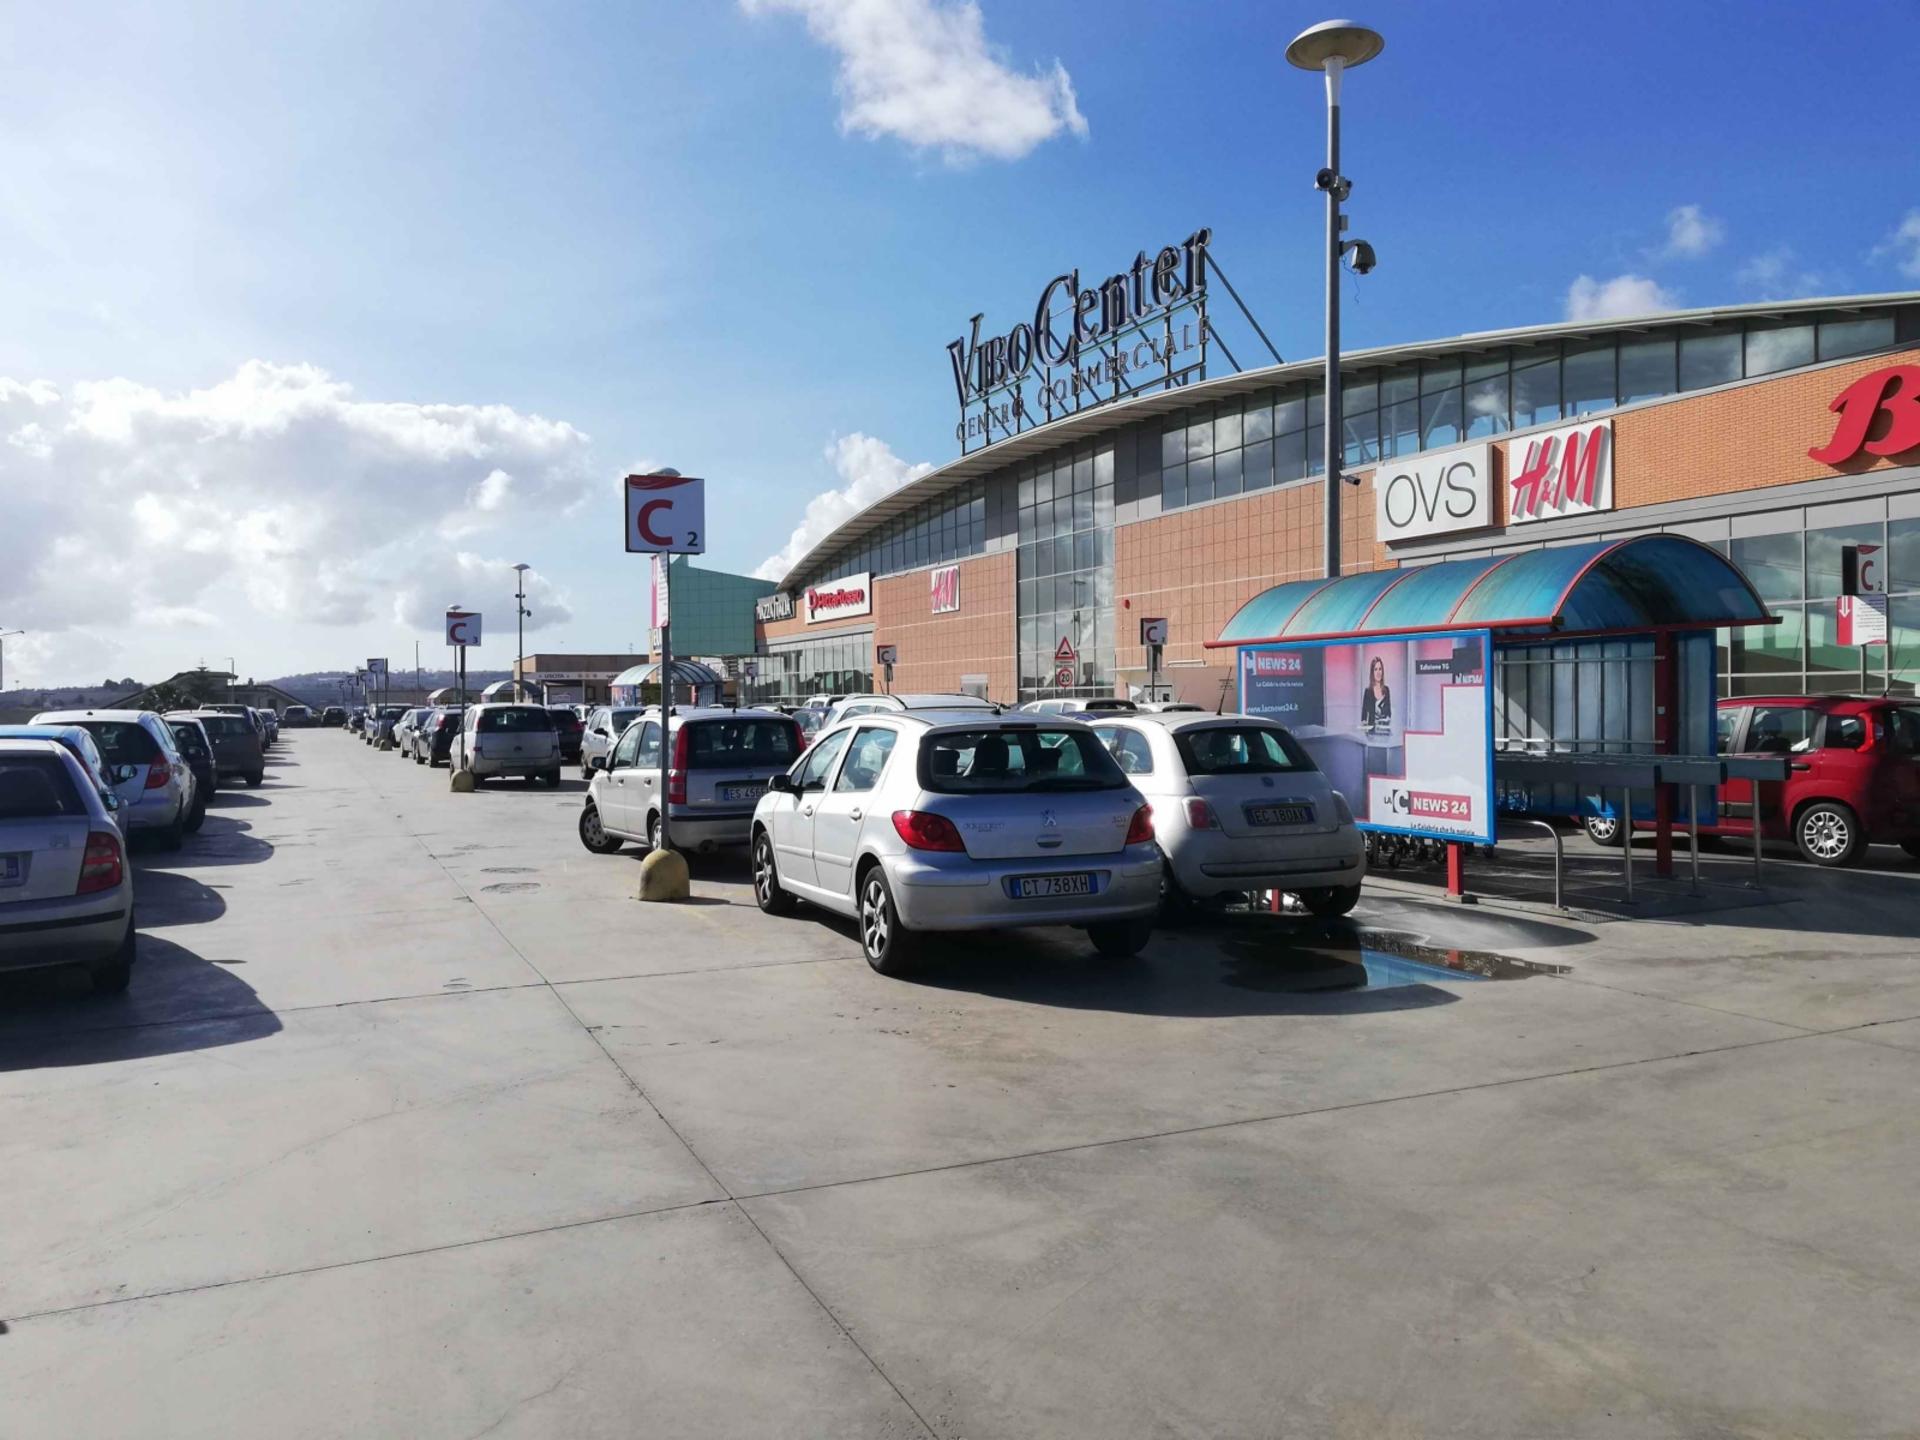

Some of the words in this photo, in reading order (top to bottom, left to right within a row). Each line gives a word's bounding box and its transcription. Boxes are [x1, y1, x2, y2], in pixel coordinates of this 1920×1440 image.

[956, 396, 1025, 442] CENTRO
[1037, 314, 1211, 410] COMMERCIALE
[1510, 424, 1606, 516] H&M
[1385, 461, 1477, 529] OVS
[637, 498, 674, 547] C
[687, 531, 699, 547] 2
[1861, 560, 1874, 591] C
[450, 622, 467, 644] C
[1146, 625, 1158, 643] C
[880, 650, 889, 662] C
[1258, 657, 1287, 670] NEWS
[1288, 658, 1301, 671] 24
[1061, 672, 1071, 683] 20
[1255, 809, 1270, 824] EC
[1413, 797, 1449, 814] NEWS
[1451, 800, 1468, 816] 24
[1023, 879, 1040, 896] CT
[1044, 874, 1089, 895] 738XH
